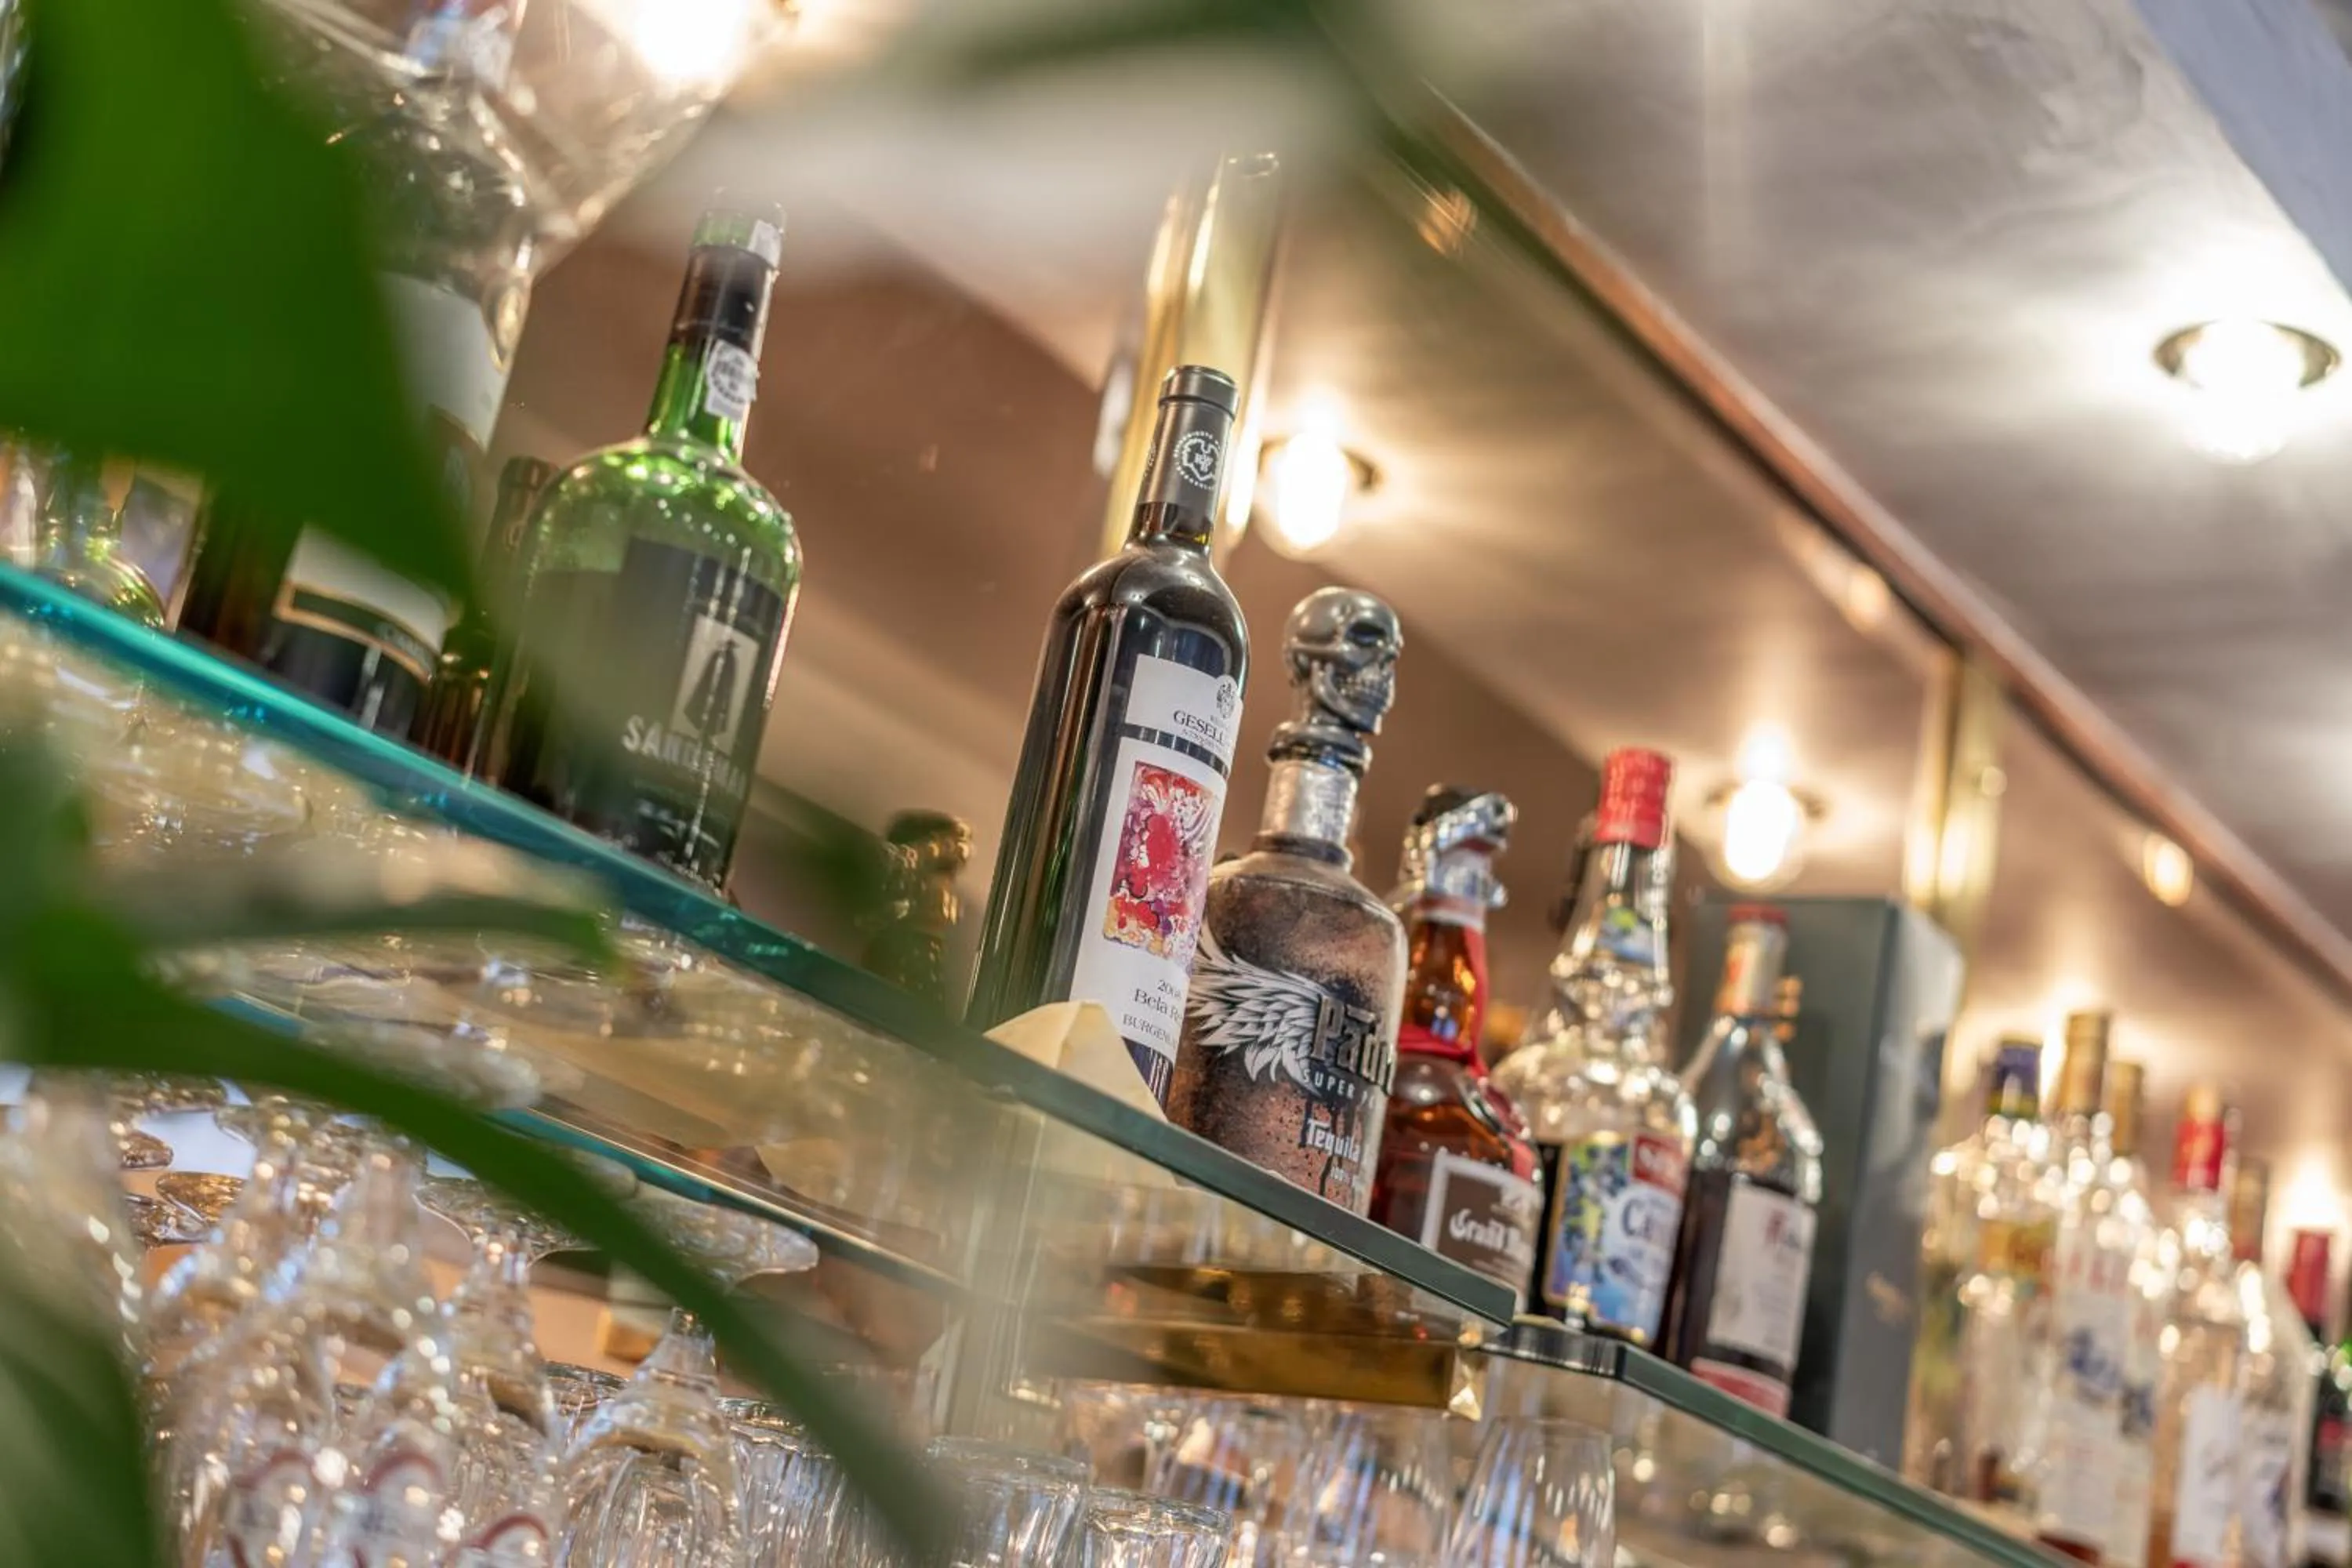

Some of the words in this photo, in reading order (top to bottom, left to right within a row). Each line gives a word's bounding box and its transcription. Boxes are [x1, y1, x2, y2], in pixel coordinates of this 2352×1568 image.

[622, 714, 747, 800] SANDMA
[1303, 1069, 1356, 1099] SUPER
[1307, 1118, 1361, 1163] Tequila
